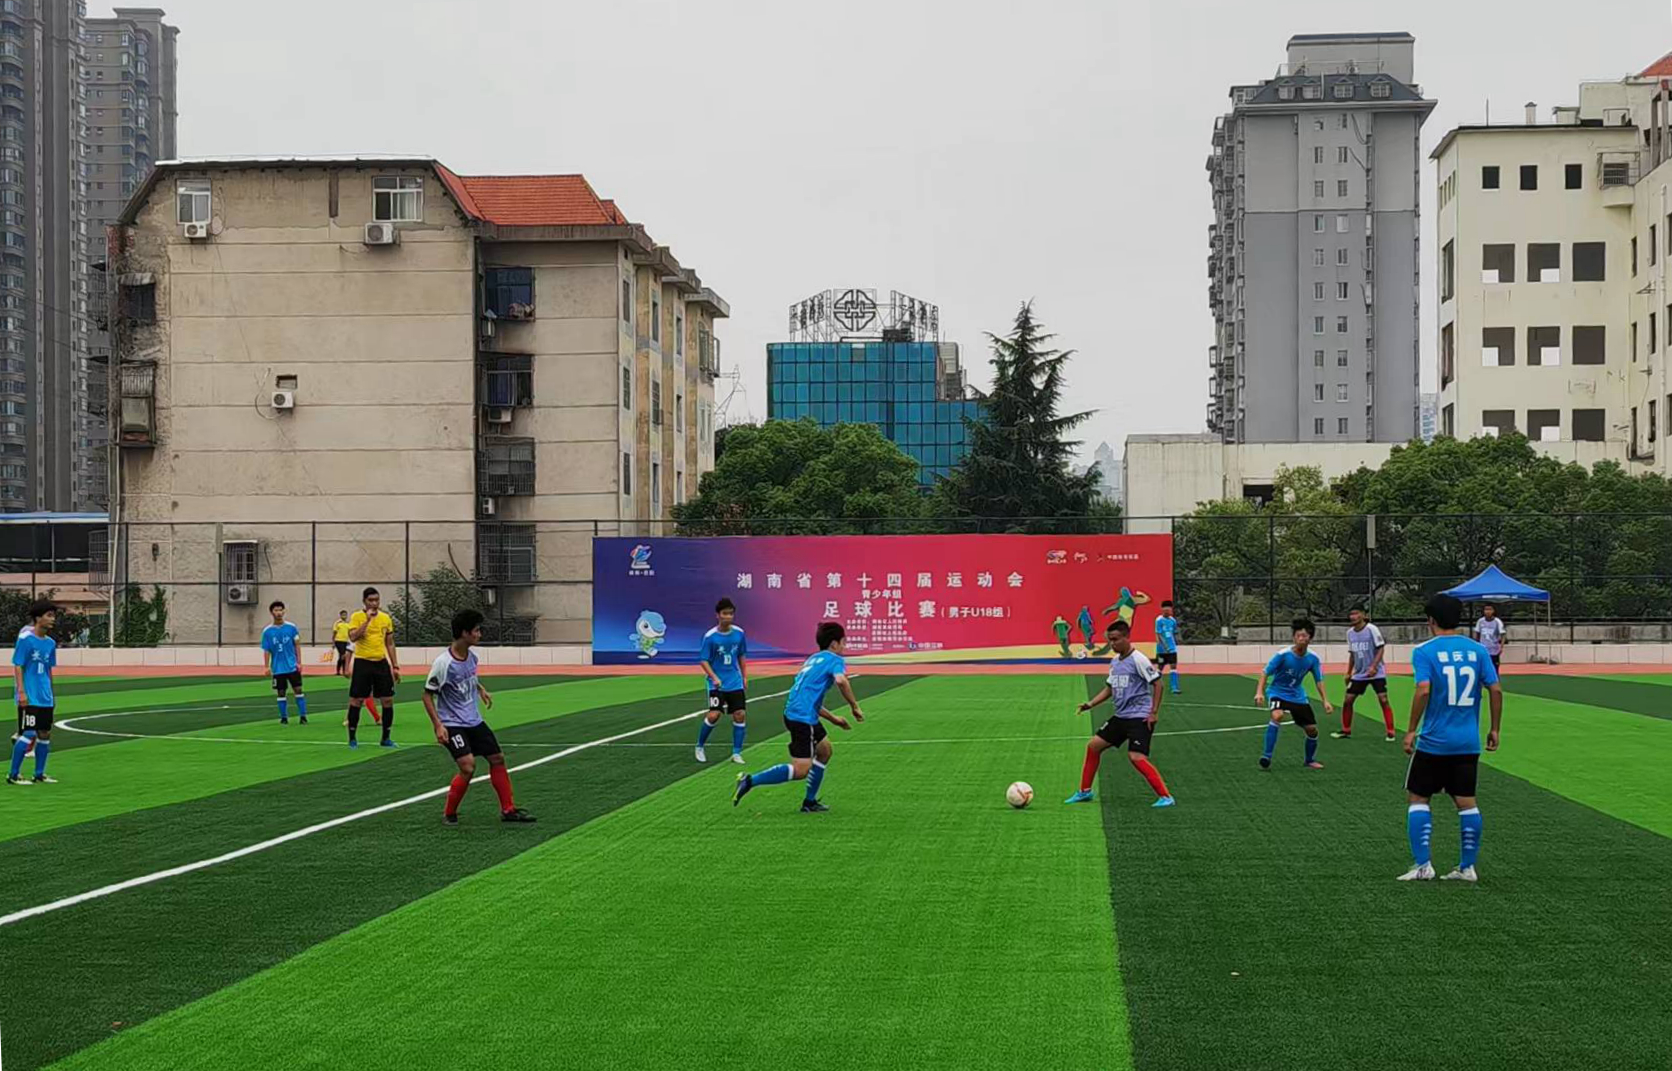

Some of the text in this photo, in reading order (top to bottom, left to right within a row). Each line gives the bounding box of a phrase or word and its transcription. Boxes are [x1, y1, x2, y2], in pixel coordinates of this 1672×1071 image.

[737, 572, 1023, 589] 湖南省第十四届运动会
[862, 589, 902, 599] 青少年组
[823, 600, 936, 618] 足球比赛
[1443, 665, 1476, 706] 12
[709, 697, 719, 707] 10
[25, 714, 36, 727] 18
[451, 734, 465, 749] 19
